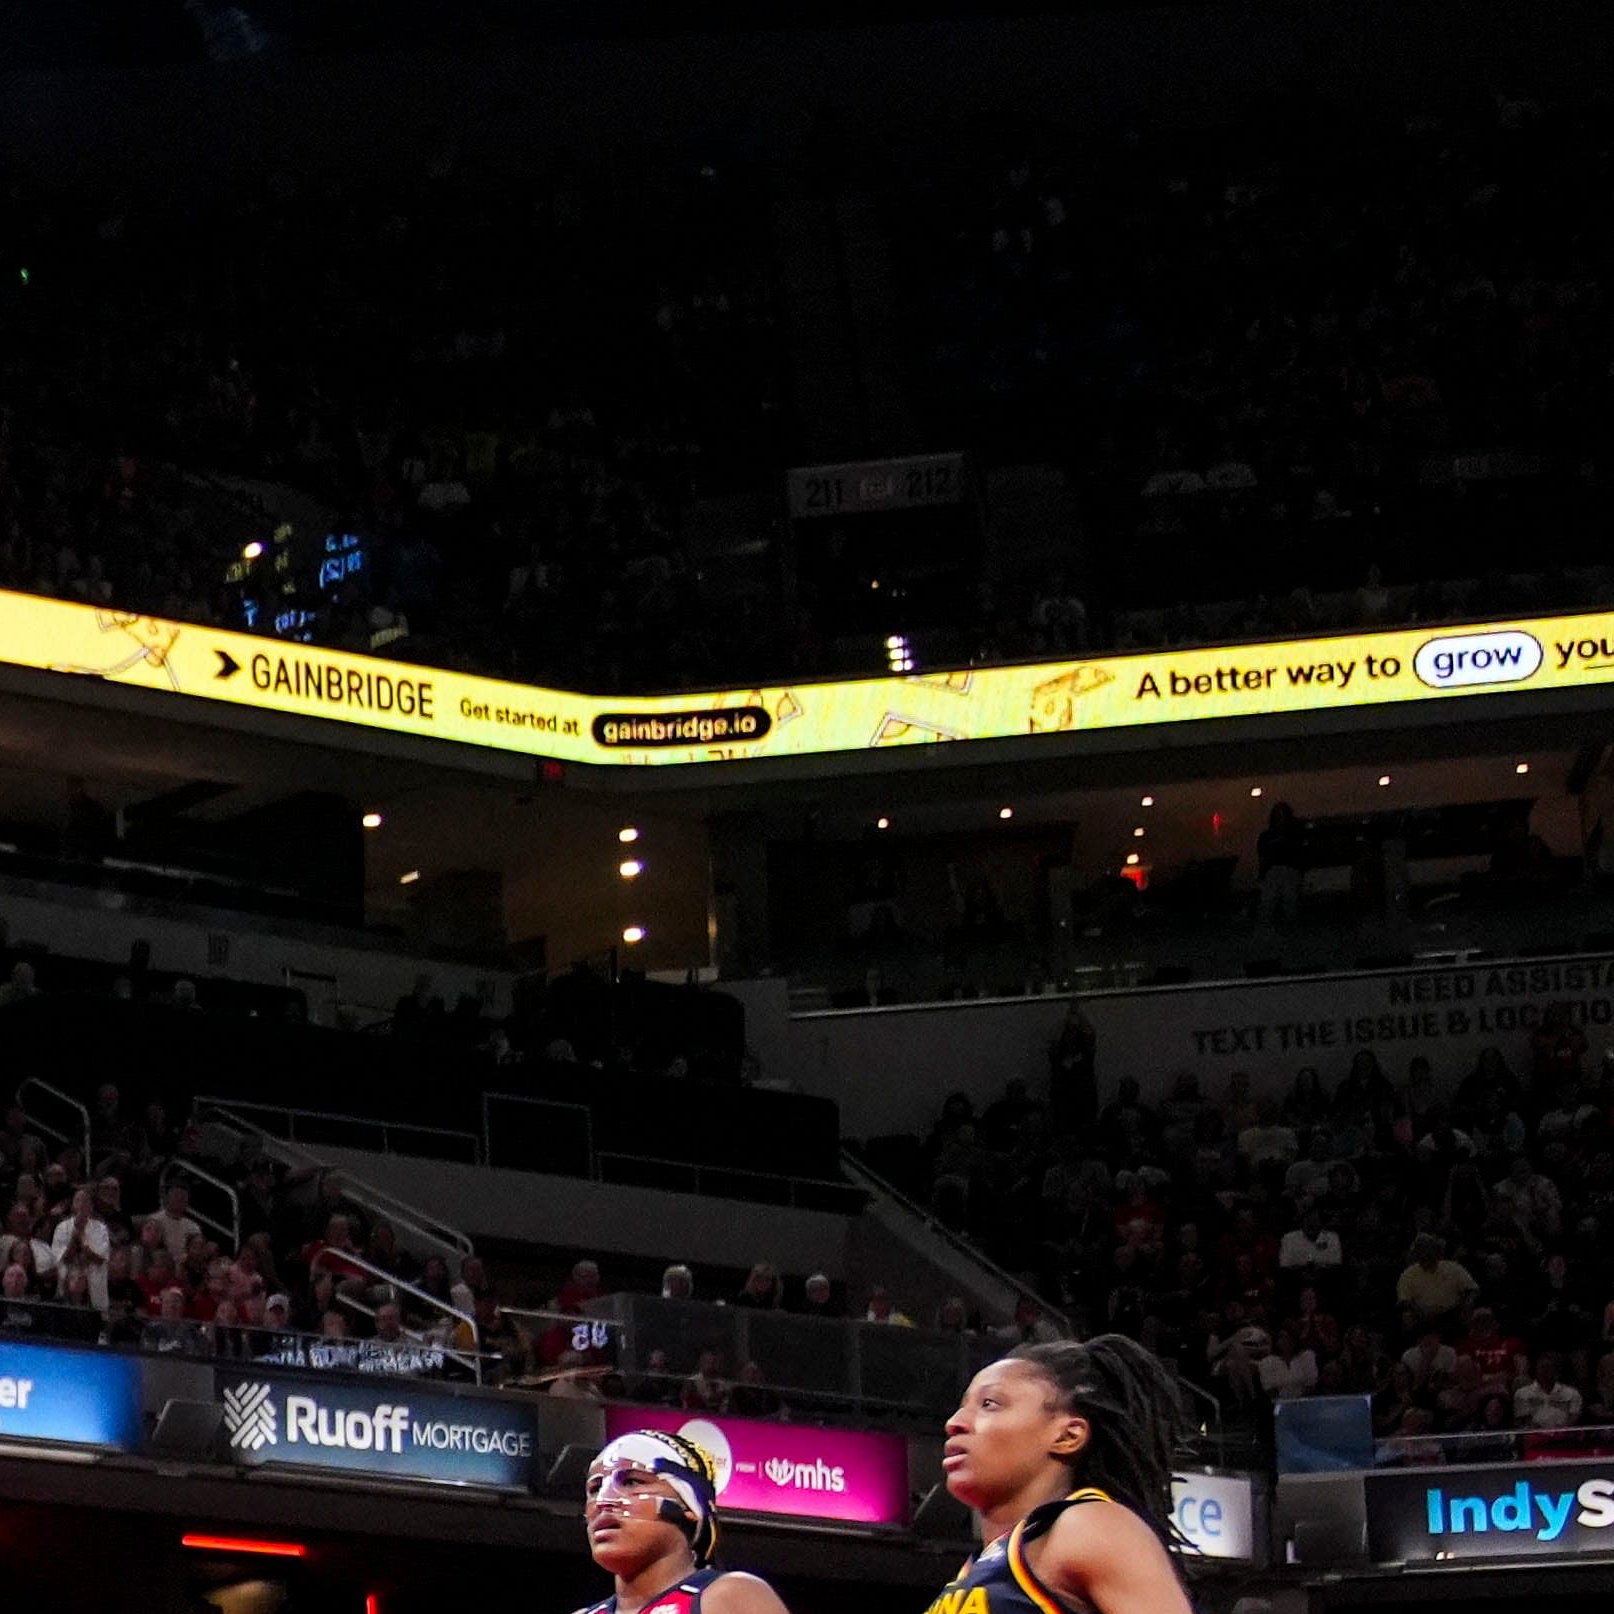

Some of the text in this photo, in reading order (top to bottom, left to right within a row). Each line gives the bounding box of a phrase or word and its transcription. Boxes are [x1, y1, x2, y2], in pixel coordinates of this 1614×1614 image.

[251, 652, 434, 719] GAINBRIDGE
[1136, 673, 1161, 700] A
[1169, 666, 1276, 696] better
[1286, 656, 1357, 690] way
[1365, 655, 1402, 679] to
[1432, 644, 1524, 679] grow
[460, 700, 580, 737] Get started at
[602, 713, 758, 746] gainbridge.io
[1387, 973, 1475, 1006] NEED
[1192, 1026, 1268, 1055] TEXT
[1275, 1019, 1340, 1051] THE
[1345, 1010, 1441, 1045] ISSUE
[1449, 1008, 1472, 1035] &
[286, 1396, 533, 1458] Ruoff MORTGAGE
[795, 1458, 846, 1492] mhs
